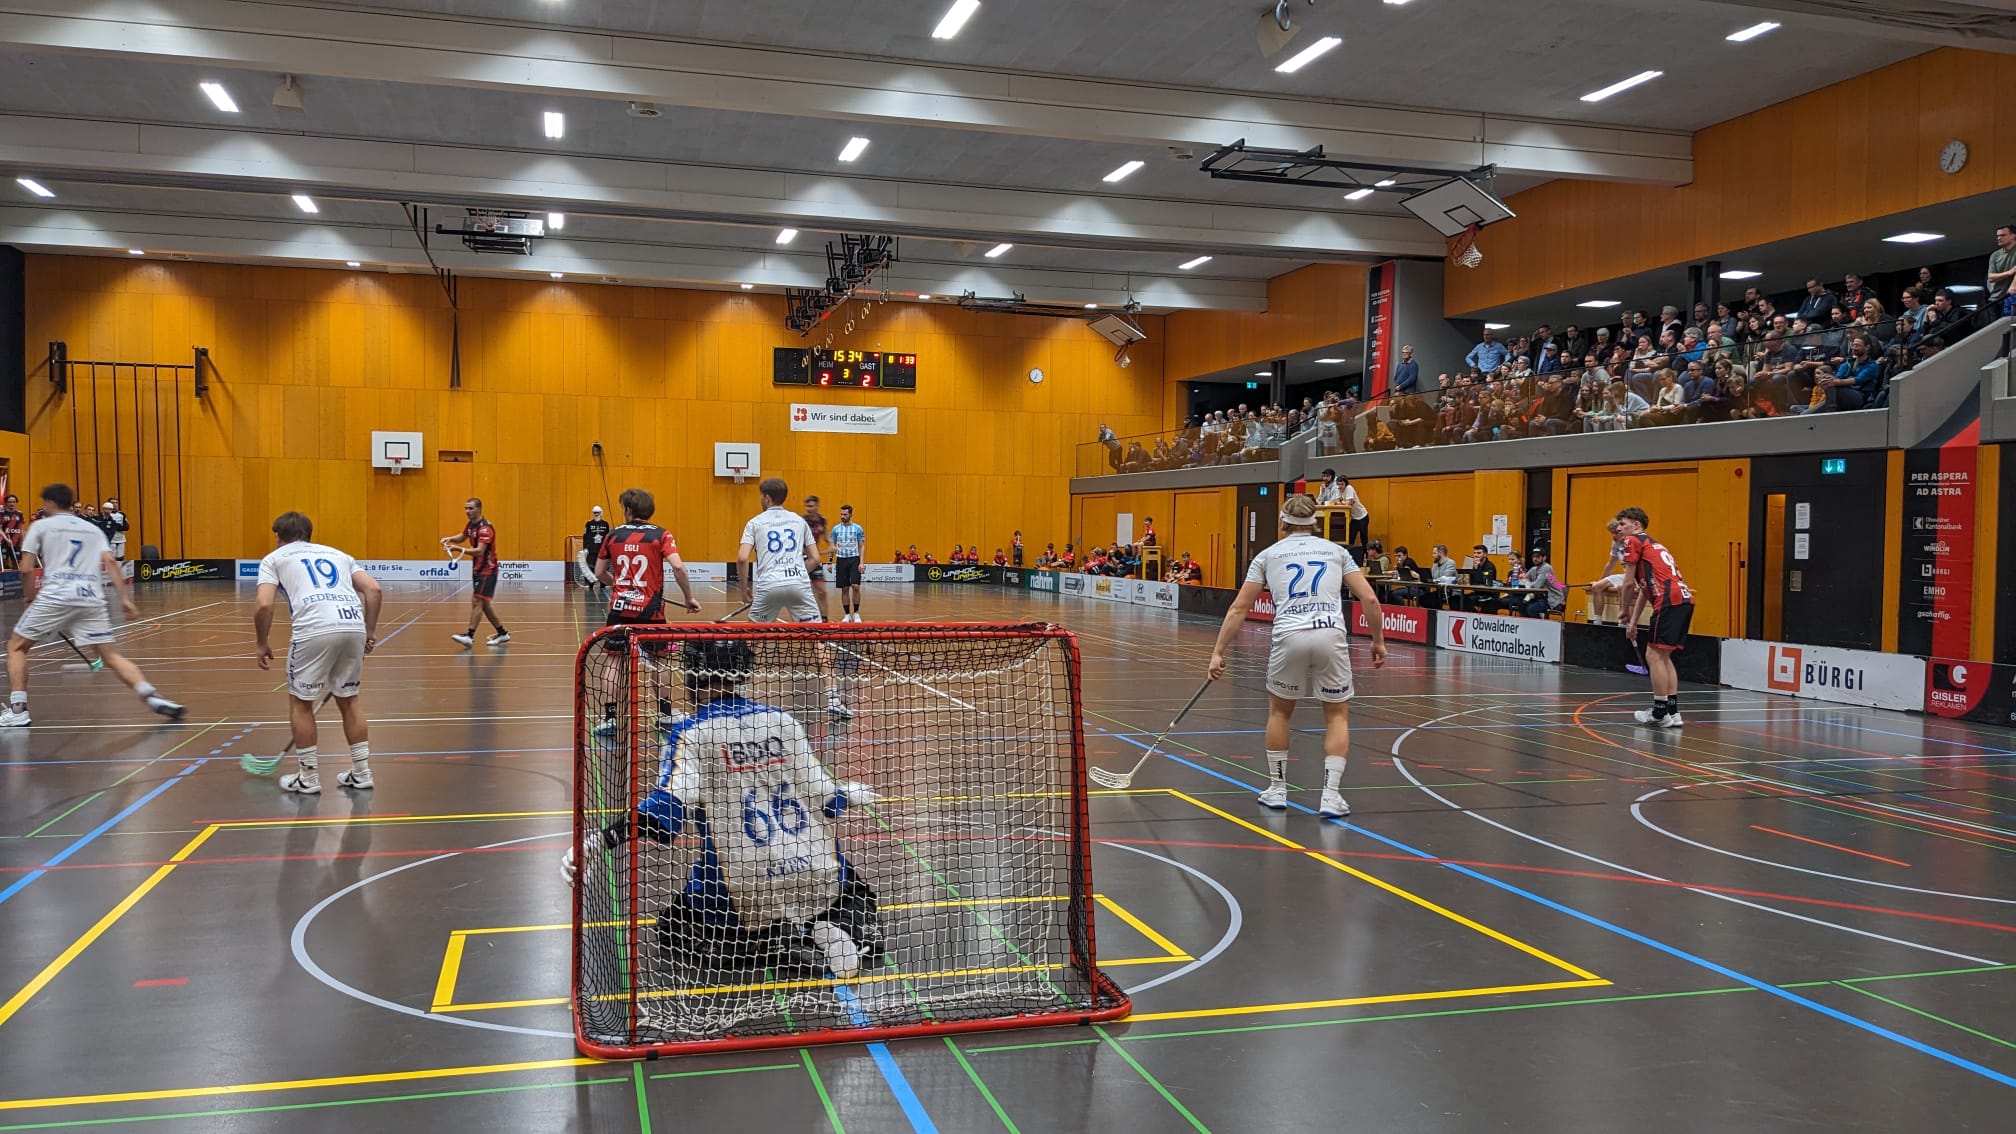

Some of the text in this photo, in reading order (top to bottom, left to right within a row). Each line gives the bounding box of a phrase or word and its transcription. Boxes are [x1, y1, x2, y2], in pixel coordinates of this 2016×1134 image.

[818, 361, 877, 371] HEIM GAST
[820, 373, 871, 387] 2 2
[843, 369, 849, 379] 3
[811, 412, 876, 423] Wir sind dabei.
[1911, 472, 1968, 481] PER ASPERA
[1916, 487, 1962, 496] AD ASTRA
[624, 544, 639, 552] EGLI
[767, 528, 798, 553] 83
[70, 539, 83, 567] 7
[152, 561, 191, 576] UNIHOC
[162, 564, 205, 579] UNIHOC
[300, 558, 340, 589] 19
[419, 567, 450, 577] orfida
[502, 572, 524, 580] Optik
[615, 554, 649, 587] 22
[1030, 571, 1053, 590] nahrin
[1286, 560, 1328, 599] 27
[303, 592, 358, 605] PEDERSEN
[1923, 586, 1946, 596] EMHO
[336, 604, 361, 620] ibk
[1254, 598, 1274, 614] Mobi
[1472, 617, 1519, 634] Obwaldner
[1471, 634, 1545, 658] Kantonalbank
[1805, 660, 1864, 691] BÜRGI
[1931, 691, 1967, 704] GISLER
[1931, 699, 1967, 711] REKLAMEN
[743, 781, 808, 847] 66
